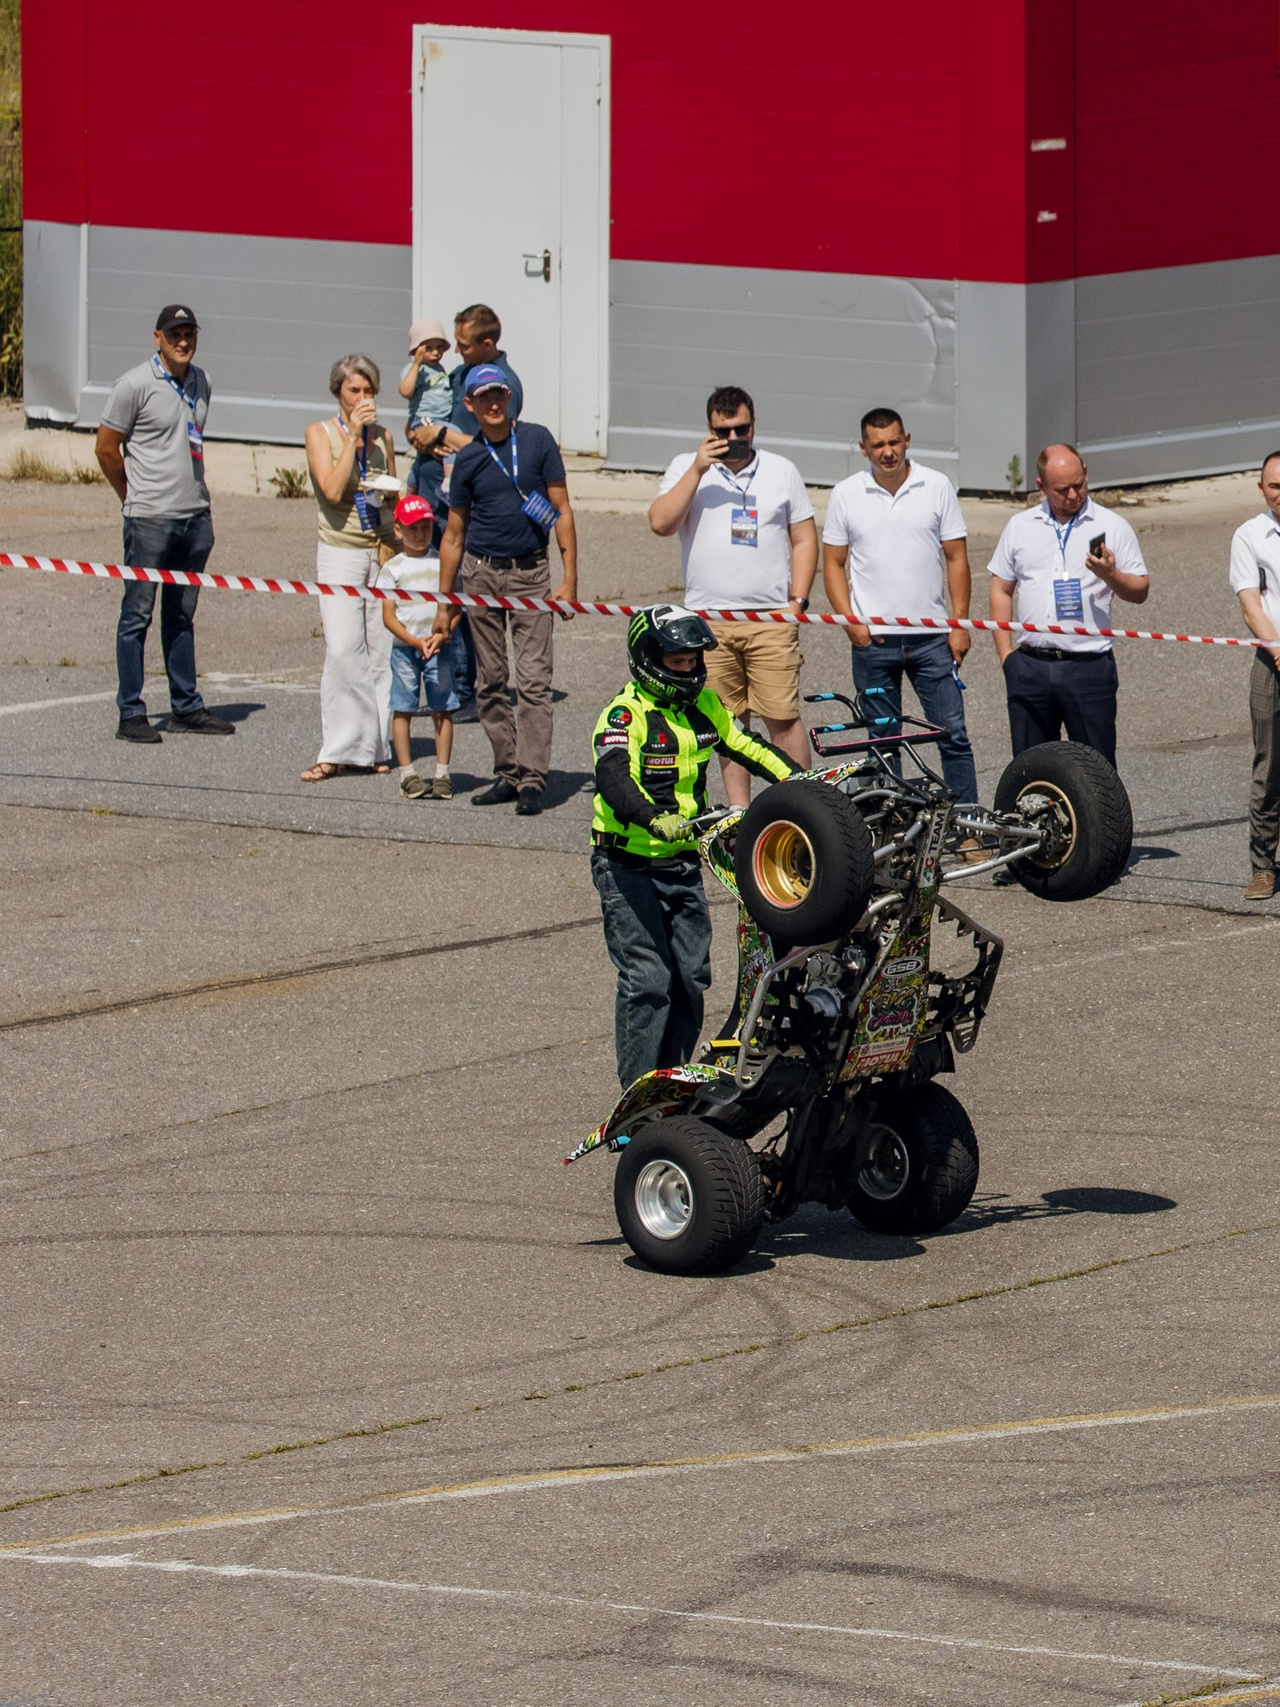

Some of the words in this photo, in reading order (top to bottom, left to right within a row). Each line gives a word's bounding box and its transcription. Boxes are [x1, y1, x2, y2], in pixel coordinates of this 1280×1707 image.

[605, 734, 629, 744] MOTUL
[645, 757, 675, 765] MOTUL
[927, 812, 946, 854] TEAM
[886, 961, 918, 974] GSB
[856, 1051, 901, 1069] MOTUL
